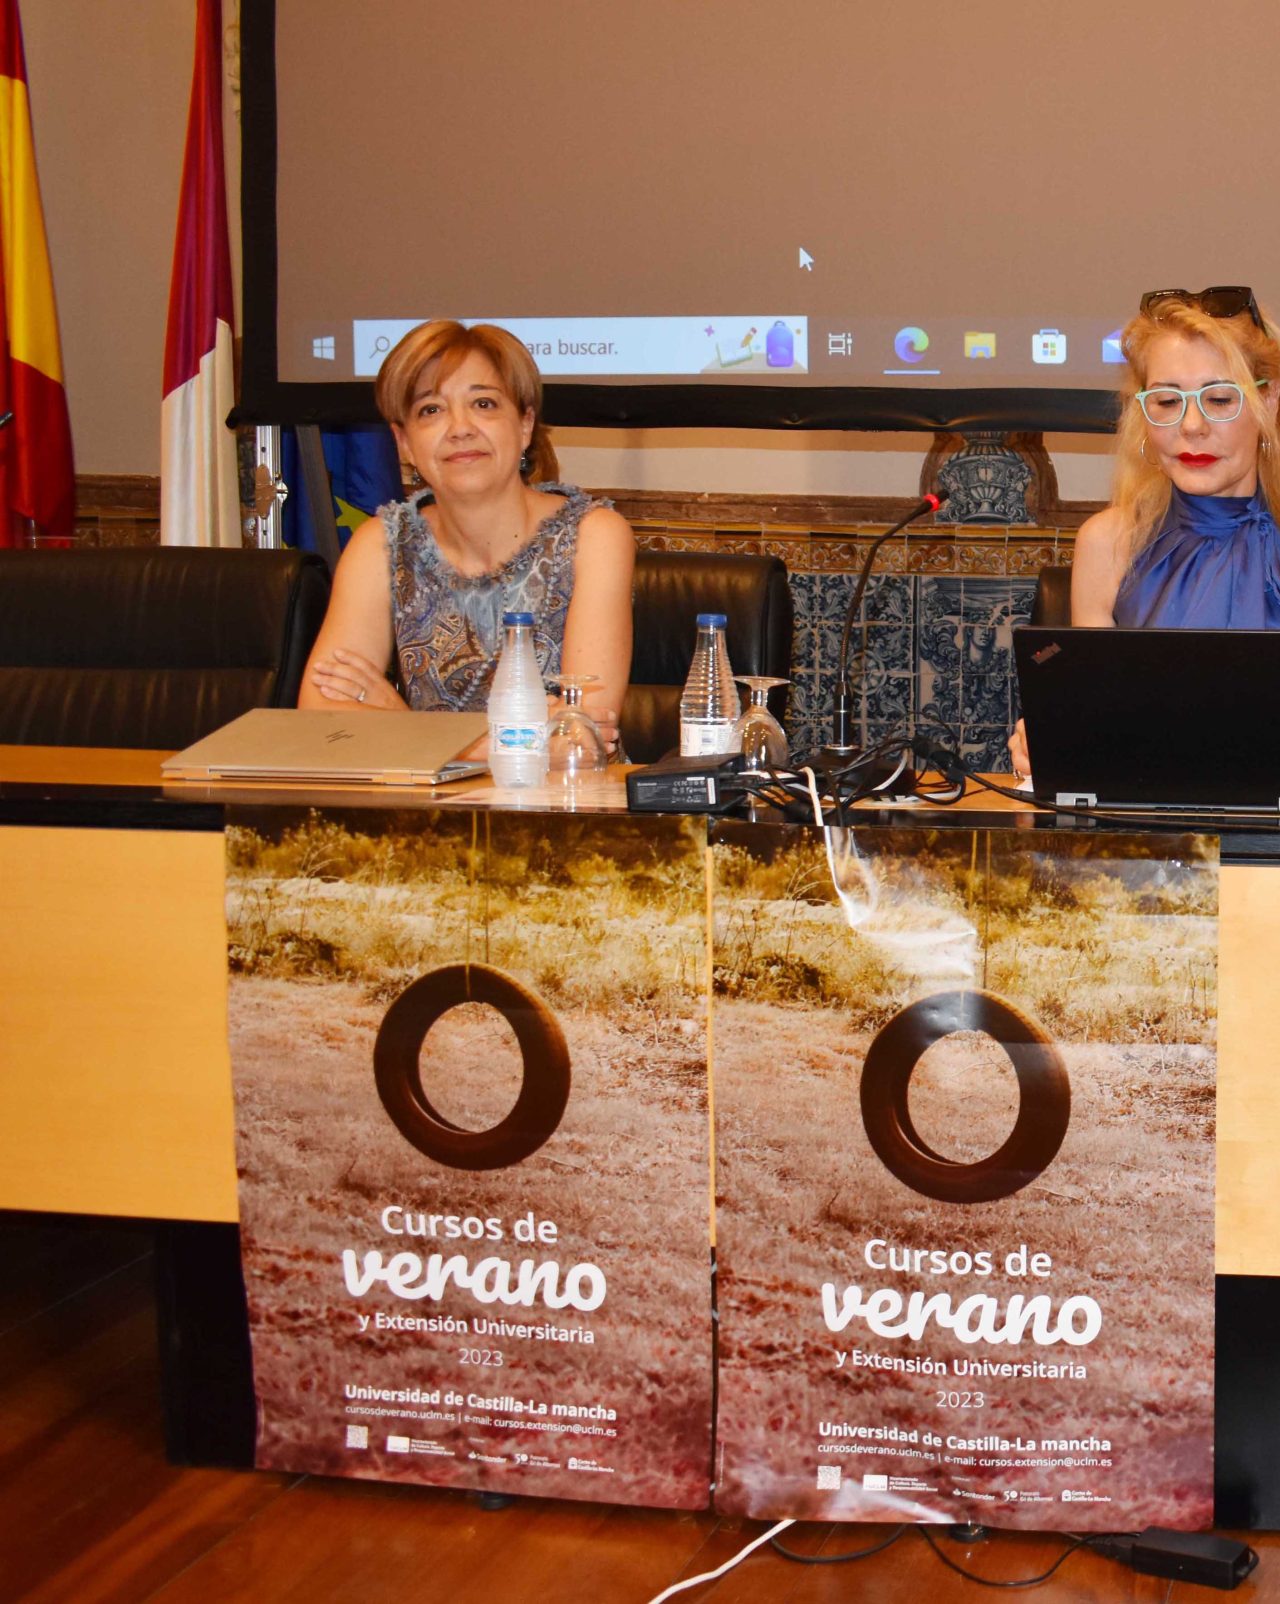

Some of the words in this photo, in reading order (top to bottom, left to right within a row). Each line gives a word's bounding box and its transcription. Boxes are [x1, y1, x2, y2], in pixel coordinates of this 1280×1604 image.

[527, 342, 552, 356] ara
[558, 338, 618, 356] buscar.
[381, 1205, 503, 1241] Cursos
[513, 1211, 559, 1243] de
[864, 1238, 993, 1277] Cursos
[1004, 1245, 1052, 1277] de
[342, 1248, 607, 1312] verano
[358, 1313, 371, 1332] y
[375, 1311, 468, 1334] Extensión
[473, 1317, 595, 1344] Universitaria
[822, 1282, 1102, 1346] verano
[458, 1347, 504, 1367] 2023
[835, 1350, 848, 1367] y
[852, 1349, 947, 1375] Extensión
[953, 1358, 1087, 1380] Universitaria
[345, 1384, 441, 1404] Universidad
[444, 1390, 464, 1406] de
[467, 1393, 547, 1415] Castilla-La
[552, 1403, 617, 1421] mancha
[935, 1390, 985, 1408] 2023
[345, 1405, 455, 1421] cursosdeverano.uclm.es
[464, 1414, 492, 1427] e-mail:
[493, 1418, 617, 1437] cursos.extension@uclm.es
[818, 1421, 918, 1443] Universidad
[922, 1432, 942, 1447] de
[946, 1435, 1037, 1451] Castilla-La
[1041, 1436, 1111, 1451] mancha
[817, 1443, 935, 1460] cursosdeverano.uclm.es
[944, 1455, 977, 1466] e-mail:
[979, 1456, 1112, 1467] cursos.extension@uclm.es
